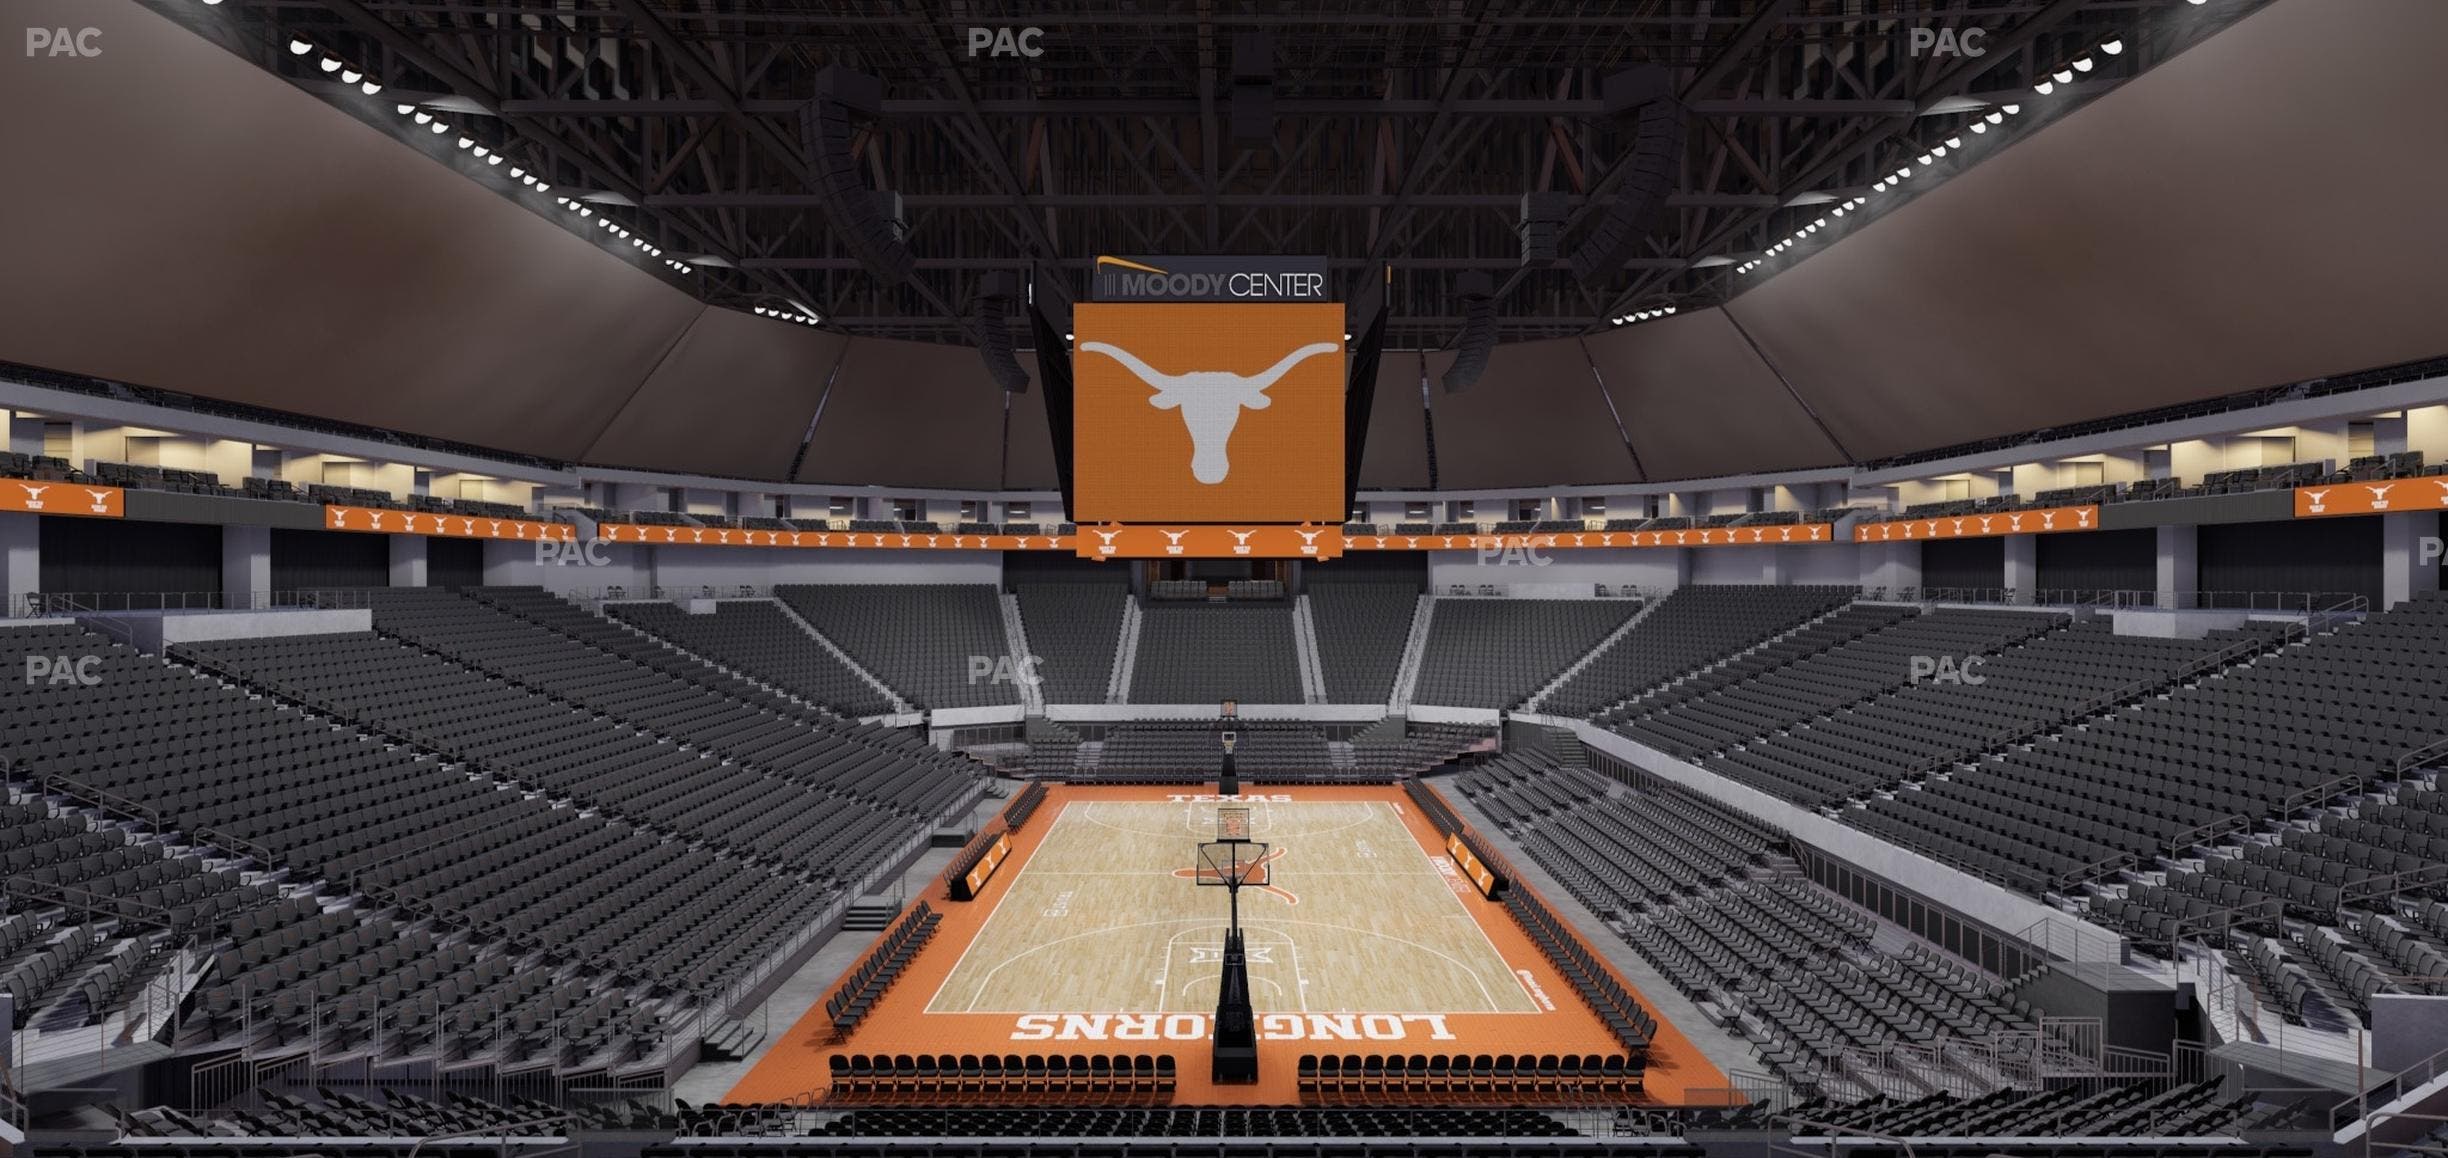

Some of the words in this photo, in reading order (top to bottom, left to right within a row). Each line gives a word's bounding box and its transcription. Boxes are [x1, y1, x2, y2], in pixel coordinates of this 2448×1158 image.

[1121, 273, 1227, 297] MOODY
[1228, 272, 1324, 297] CENTER
[1008, 1013, 1458, 1041] LONGORNS
